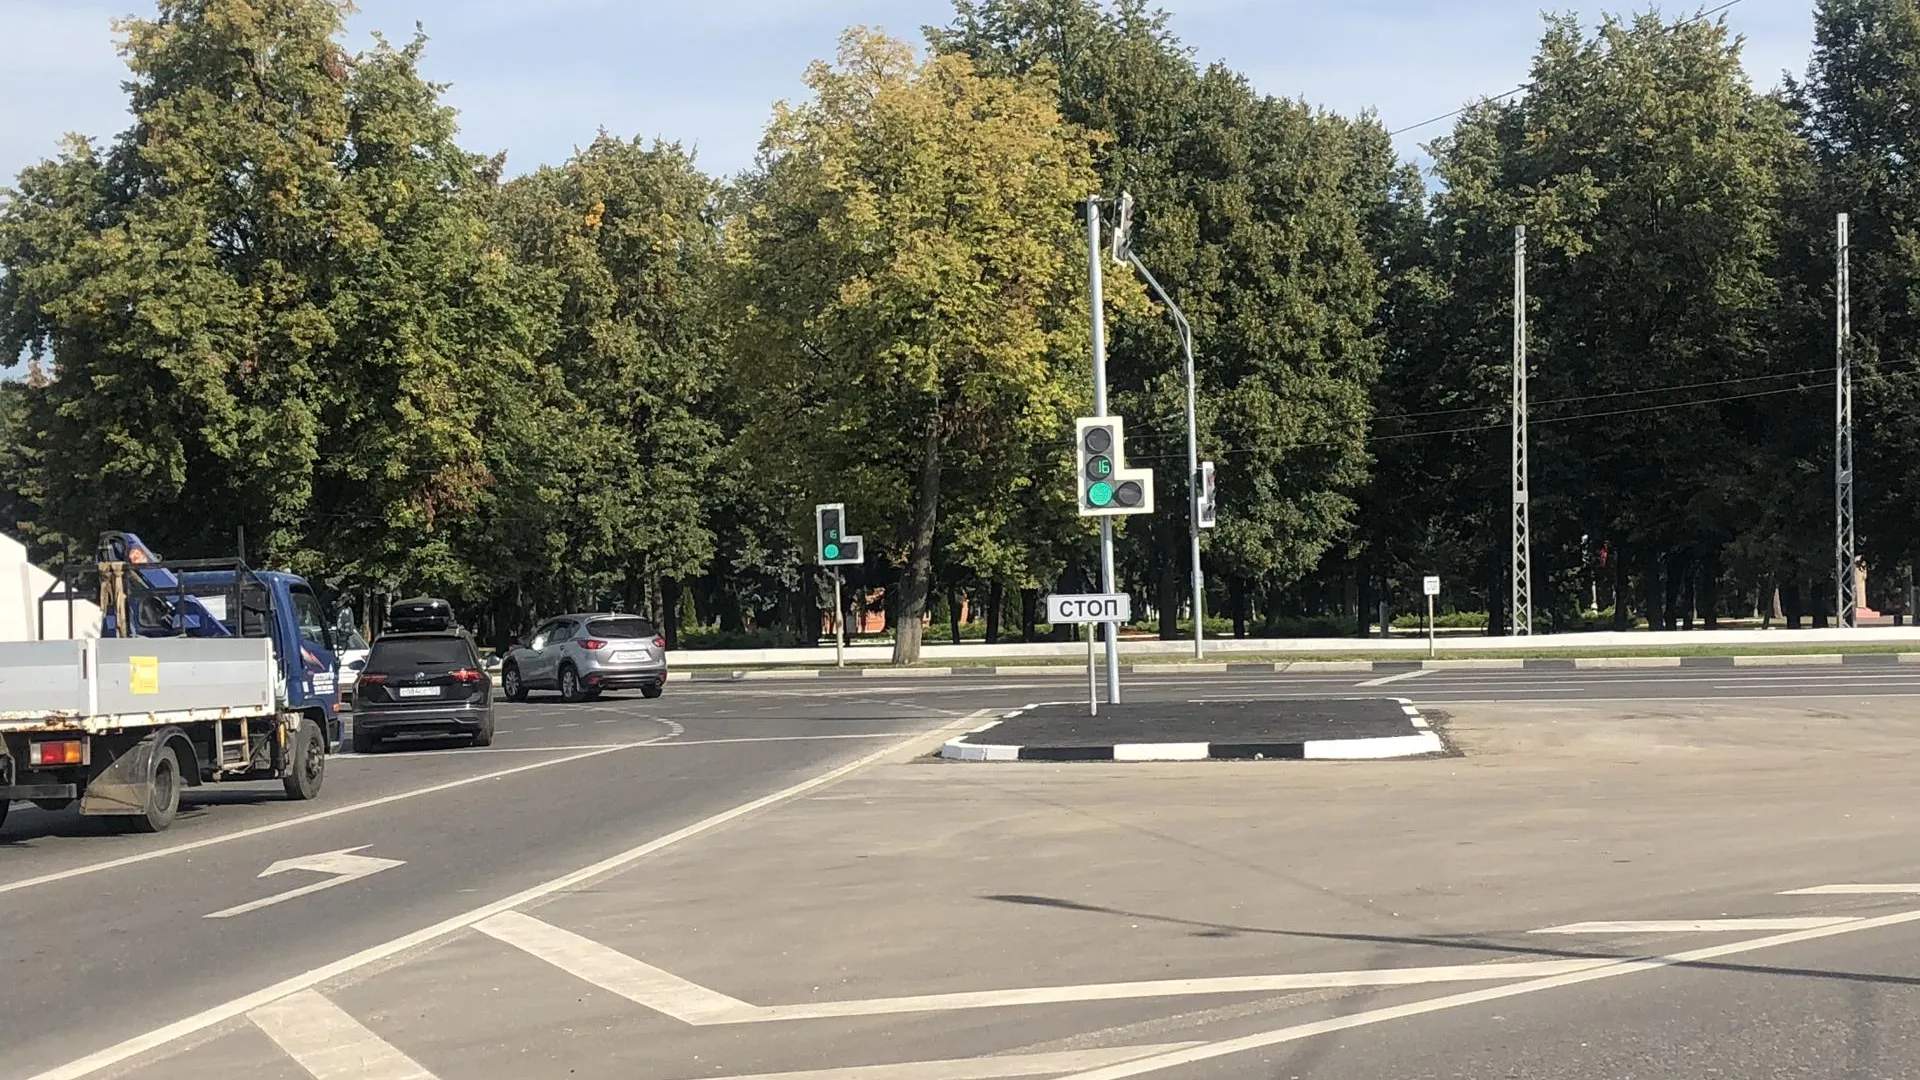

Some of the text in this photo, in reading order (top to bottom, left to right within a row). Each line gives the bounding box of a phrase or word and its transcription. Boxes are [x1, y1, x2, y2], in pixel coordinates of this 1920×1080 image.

[1098, 460, 1110, 473] 16
[829, 530, 837, 539] 16
[1059, 599, 1118, 617] СТОП
